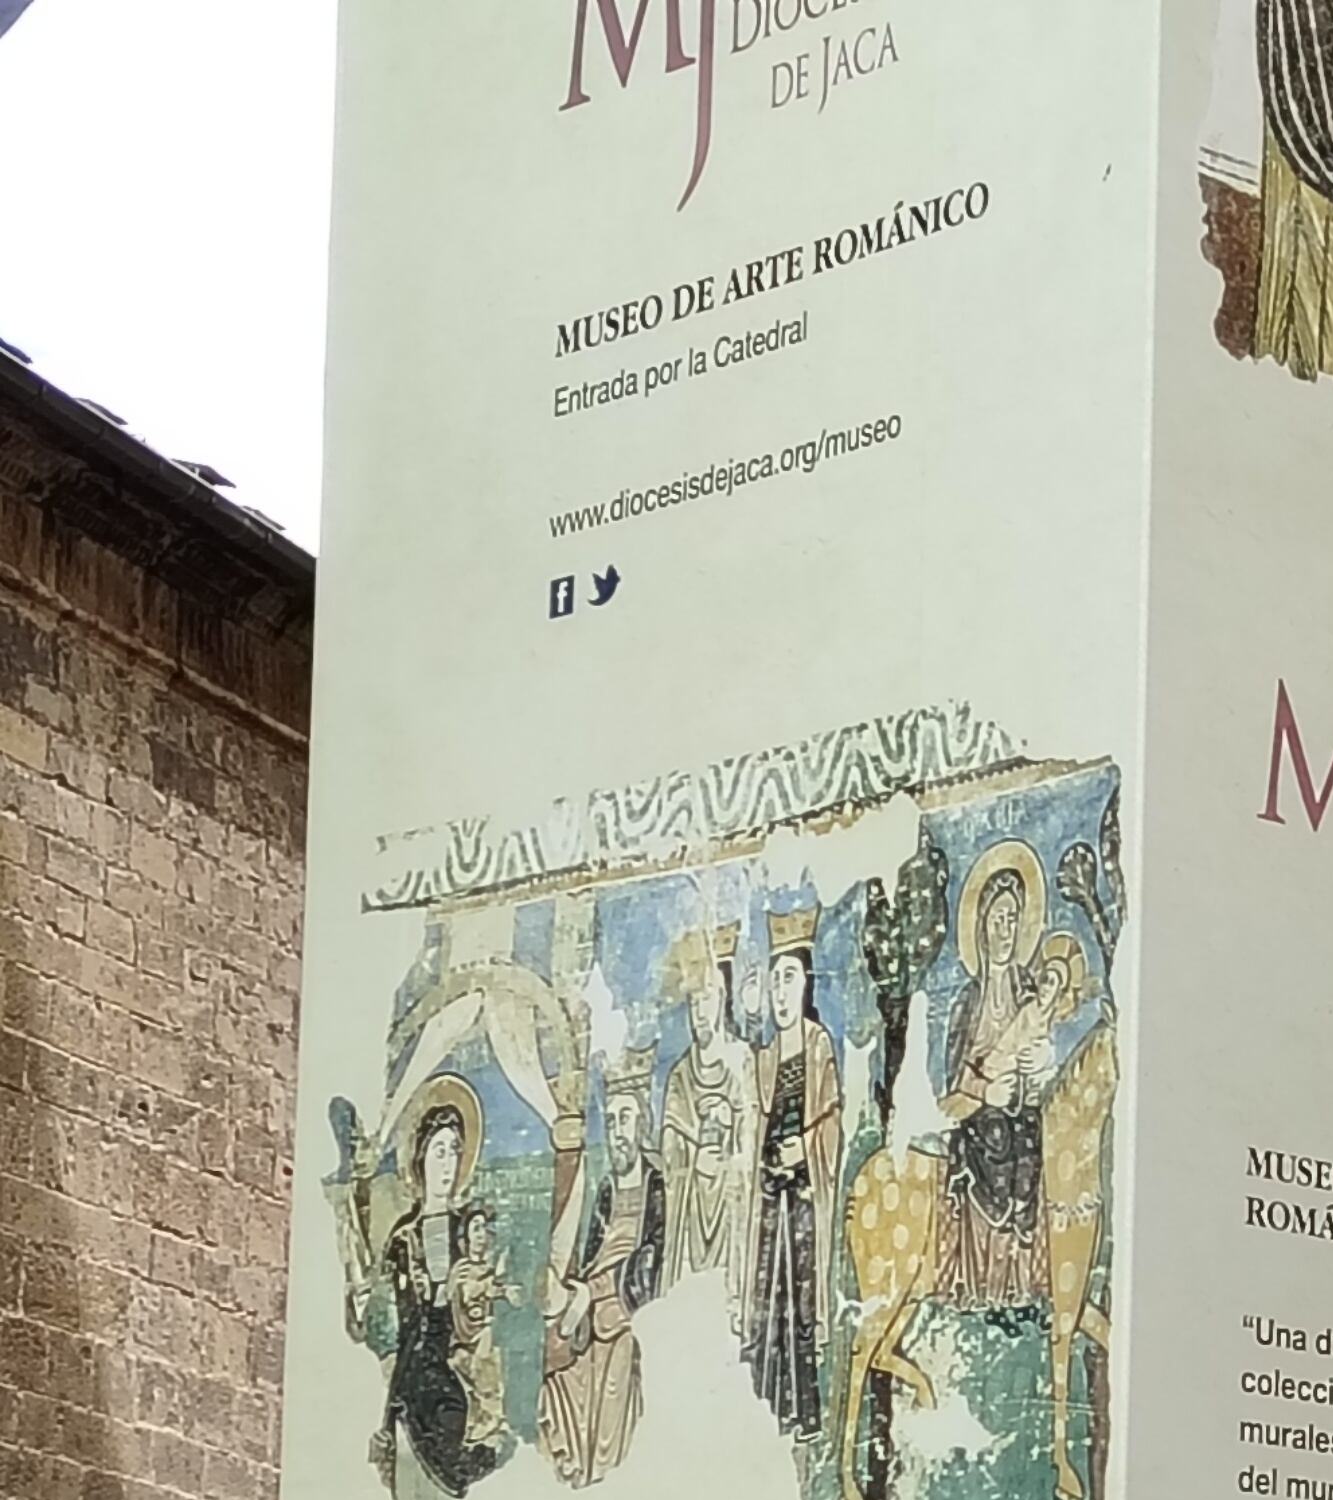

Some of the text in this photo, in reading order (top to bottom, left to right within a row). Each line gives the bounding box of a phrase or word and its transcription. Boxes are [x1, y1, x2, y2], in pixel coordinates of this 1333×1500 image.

[770, 22, 899, 115] DE JACA
[554, 181, 990, 357] MUSEO DE ARTE ROMÁNICO
[554, 310, 809, 418] Entrada por la Catedral
[549, 412, 902, 538] www.diocesisdejaca.org/museo
[1237, 1464, 1278, 1496] del
